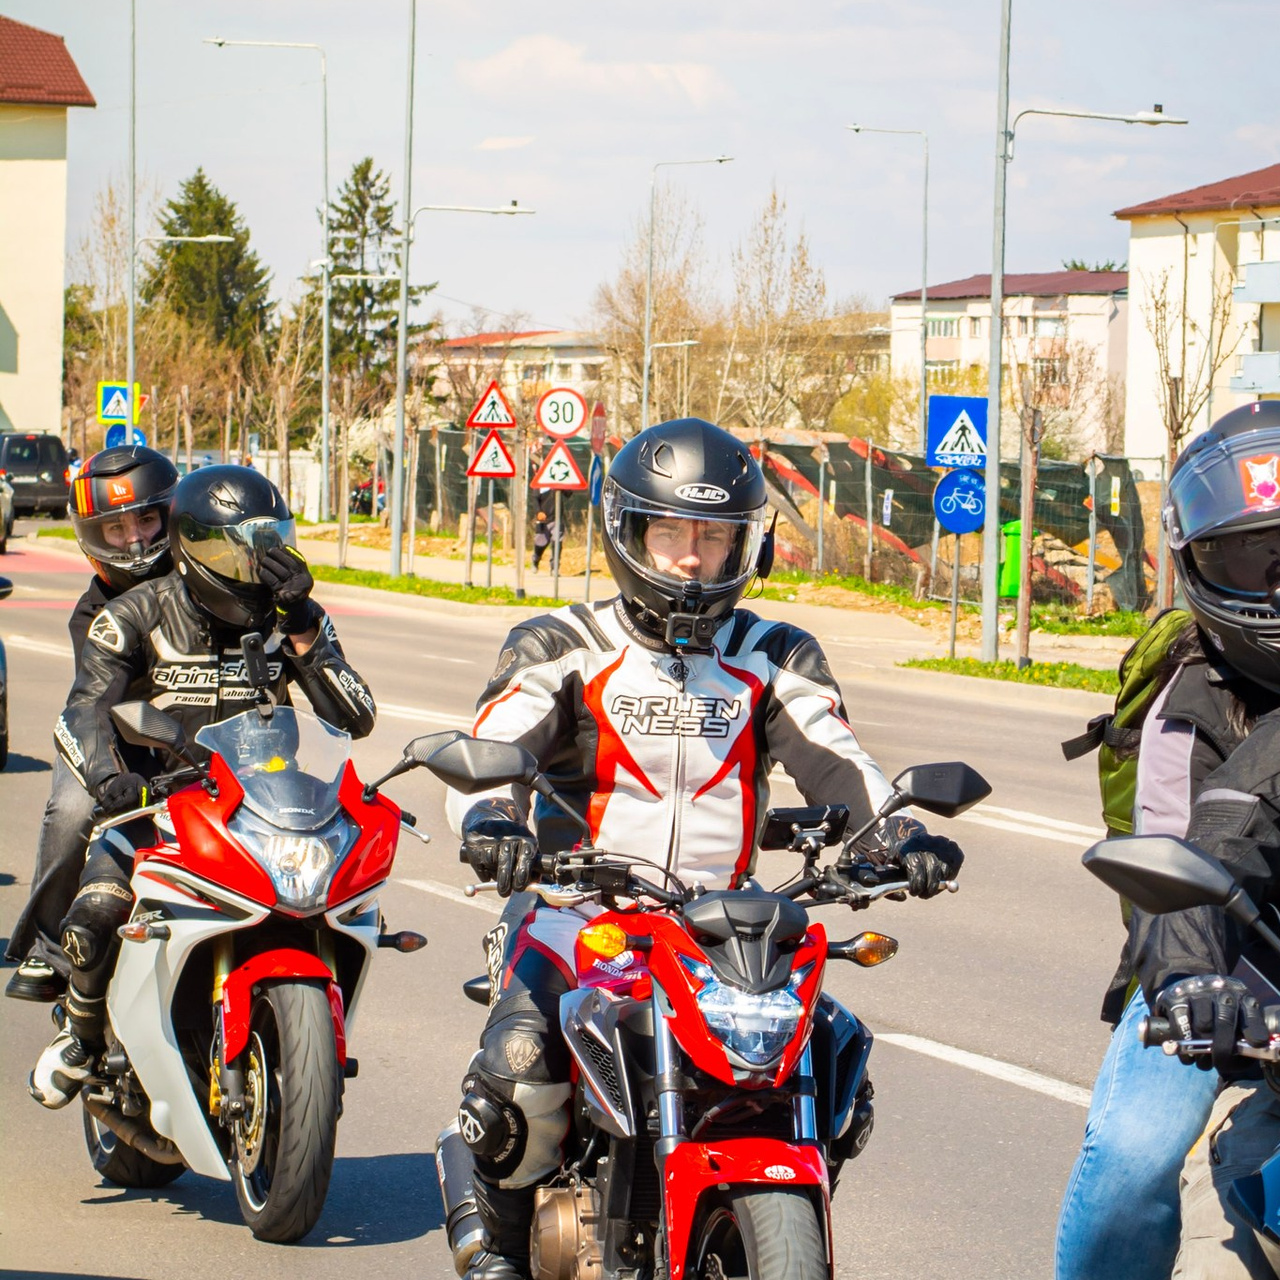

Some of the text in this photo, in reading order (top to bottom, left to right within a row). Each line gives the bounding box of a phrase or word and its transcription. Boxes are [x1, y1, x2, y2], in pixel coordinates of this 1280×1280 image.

[549, 401, 574, 424] 30
[682, 487, 725, 501] HJC
[153, 661, 282, 688] alpinests
[174, 695, 212, 704] racing
[611, 695, 742, 720] ARLEN
[621, 715, 731, 739] NESS
[279, 807, 316, 816] HONDA
[593, 958, 625, 978] HONDA
[1177, 1014, 1193, 1040] BER
[494, 1137, 516, 1163] ARLEN
